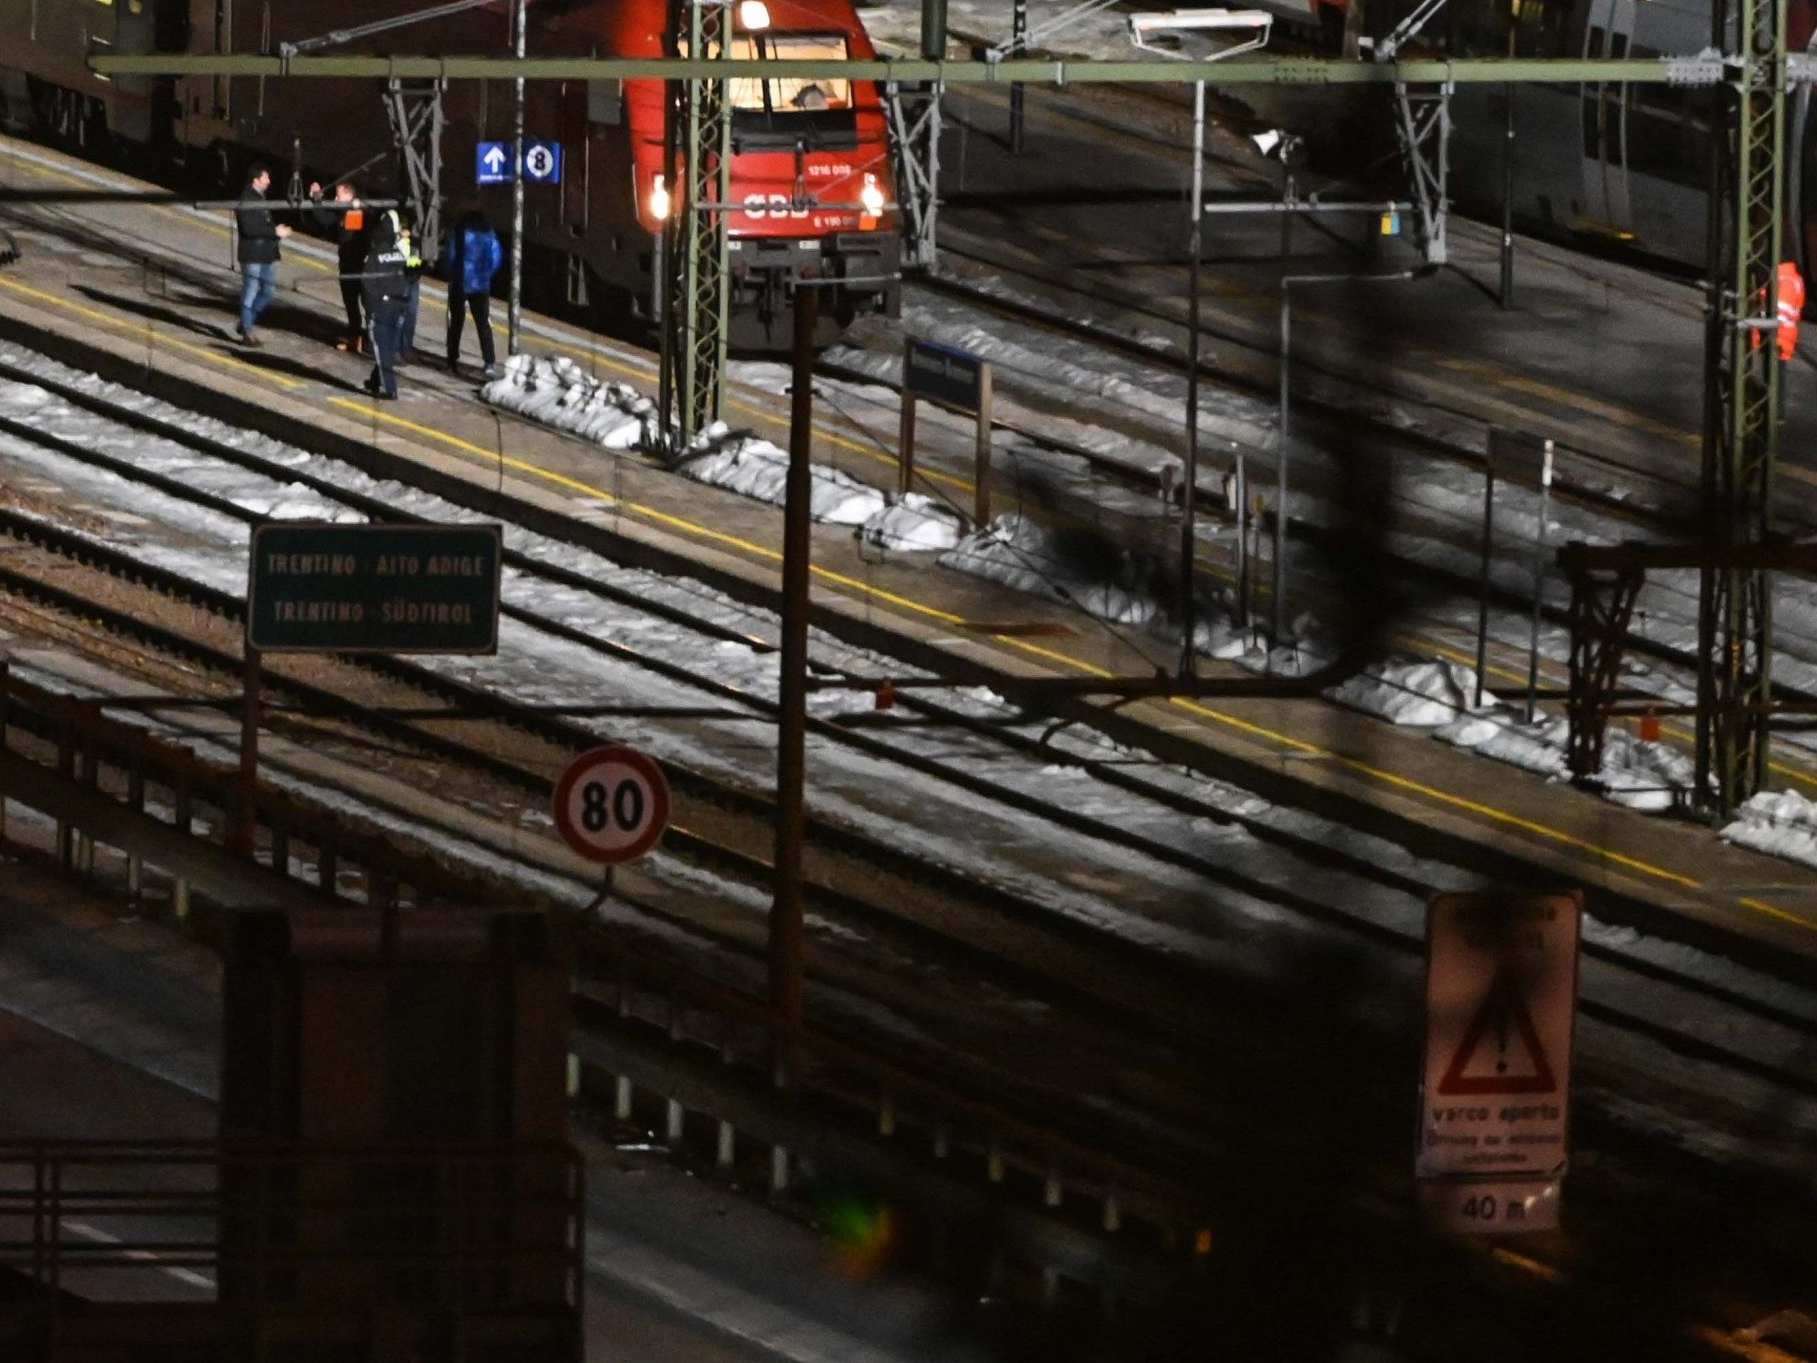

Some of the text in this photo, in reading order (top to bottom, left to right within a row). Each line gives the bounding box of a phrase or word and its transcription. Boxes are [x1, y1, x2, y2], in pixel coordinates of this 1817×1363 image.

[534, 151, 545, 171] 8
[269, 553, 357, 575] TRENTINO
[427, 554, 484, 576] ADIGE
[274, 600, 364, 622] TRENTINO
[582, 778, 644, 834] 80
[1463, 1195, 1496, 1221] 40
